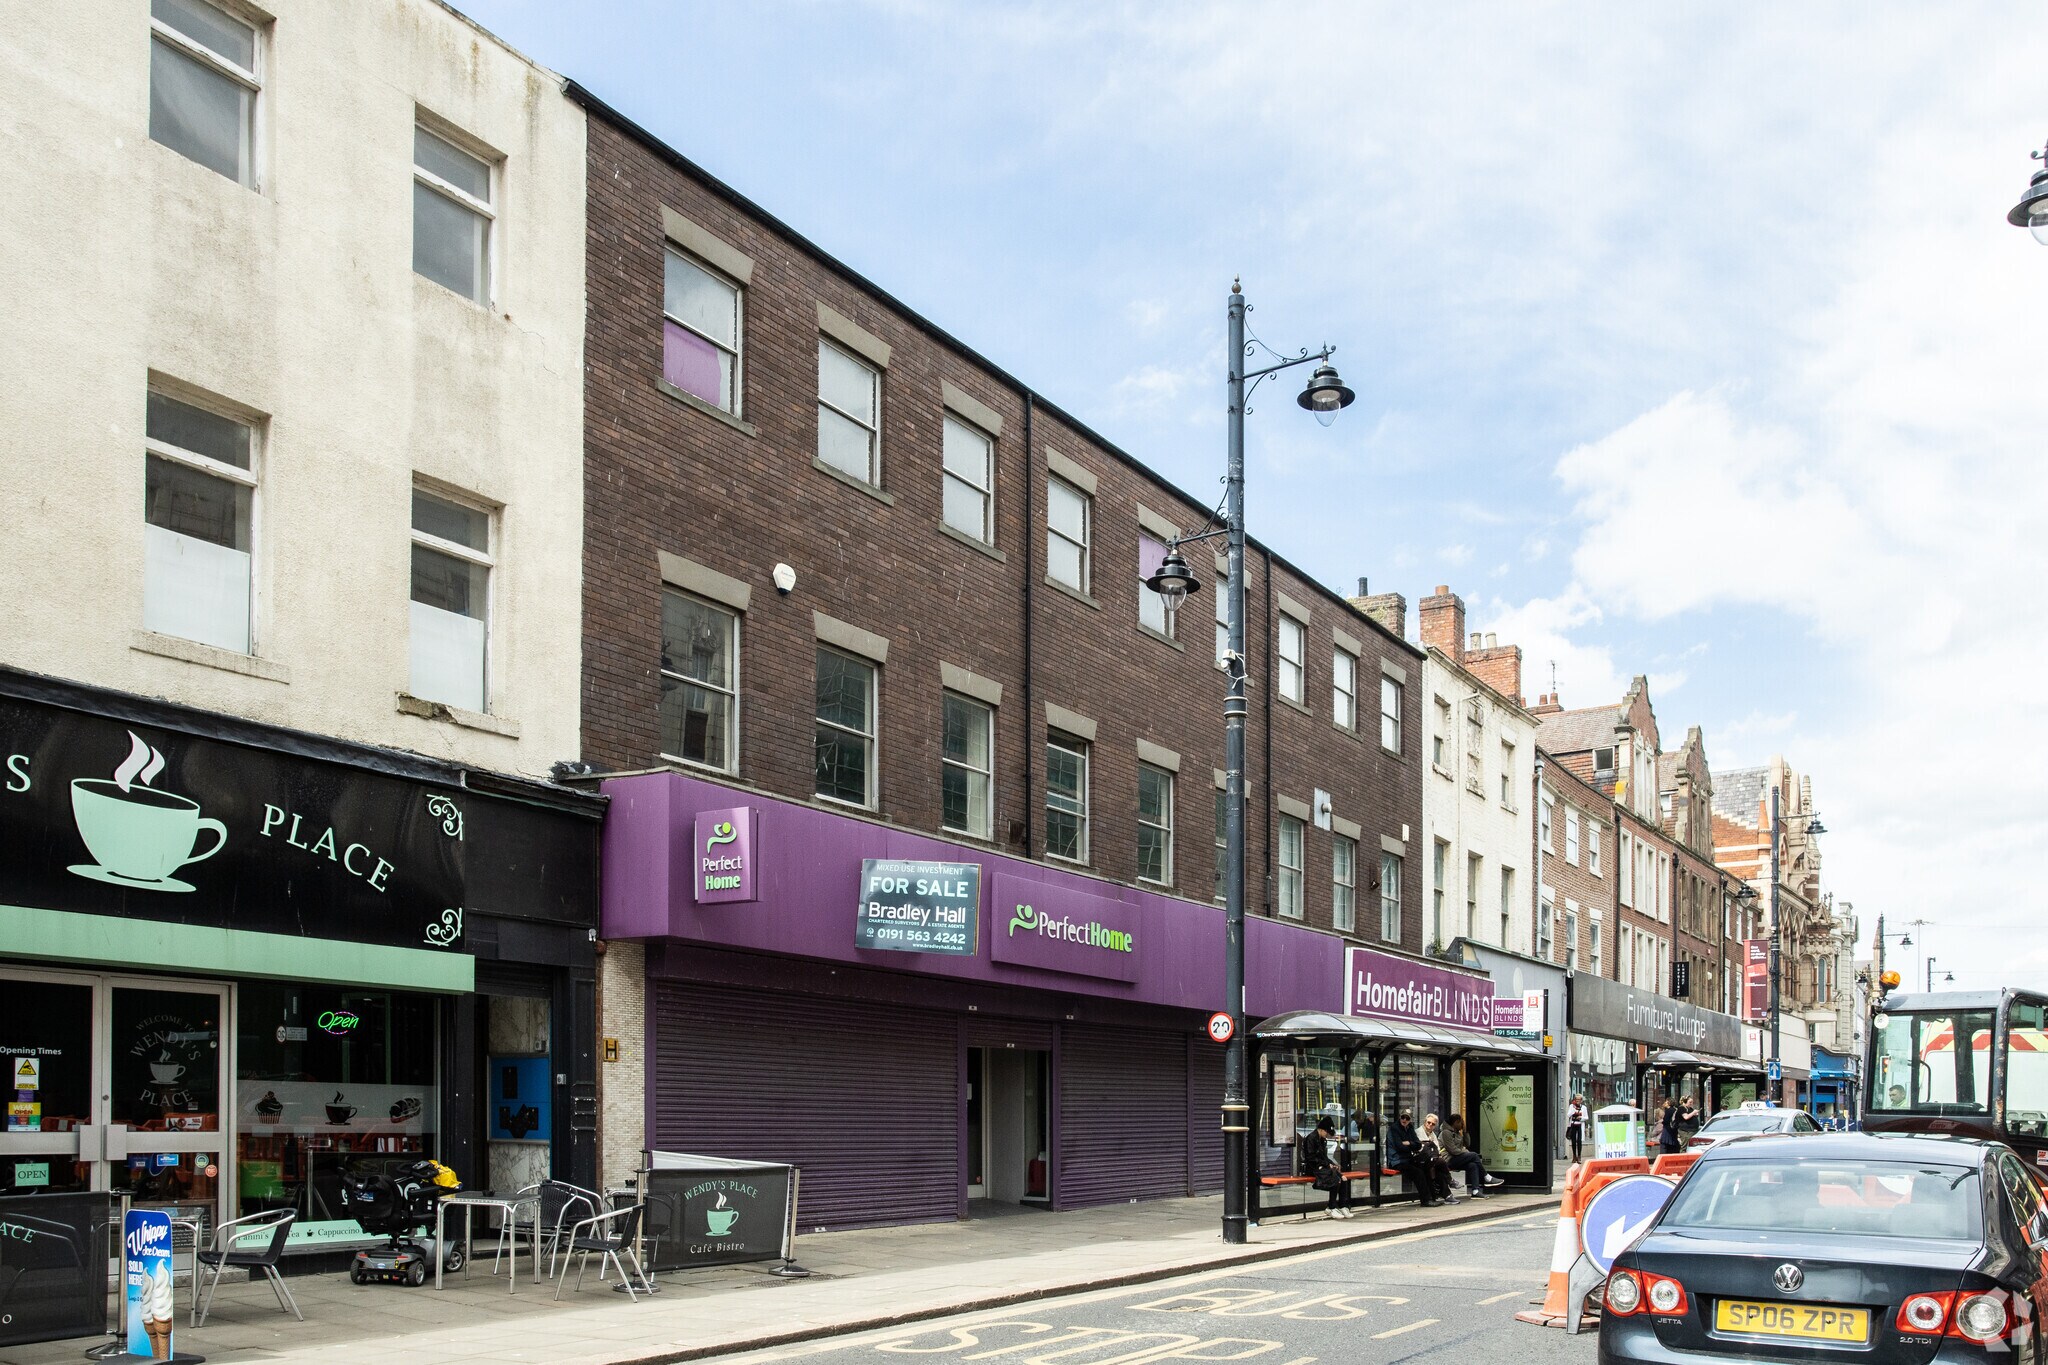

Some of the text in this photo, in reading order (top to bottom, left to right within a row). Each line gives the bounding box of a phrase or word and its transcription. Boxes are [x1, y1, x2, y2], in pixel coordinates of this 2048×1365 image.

[6, 754, 31, 792] S
[260, 803, 395, 893] PLACE
[702, 855, 742, 872] Perfect
[876, 863, 963, 875] MIXED USE INVESTMENT
[705, 875, 741, 890] Home
[869, 876, 968, 898] FOR SALE
[868, 902, 966, 926] Bradley Hall
[877, 928, 966, 944] 0191 563 4242
[1039, 911, 1133, 952] PerfectHome
[1494, 1005, 1523, 1015] Homefair
[1627, 994, 1706, 1045] Furniture Lounge
[136, 1015, 196, 1034] WELCOME TO
[318, 1011, 359, 1030] Open
[1213, 1021, 1230, 1033] 20
[0, 1046, 62, 1055] Opening Times
[130, 1030, 201, 1060] WENDY'S
[605, 1040, 617, 1059] H
[139, 1089, 193, 1107] PLACE
[1615, 1080, 1633, 1102] SALE
[17, 1170, 47, 1180] OPEN
[684, 1180, 758, 1200] WENDY'S PLACE
[127, 1220, 168, 1256] Whippy
[317, 1226, 360, 1238] Cappuccino
[152, 1246, 170, 1257] Cream
[690, 1242, 745, 1254] Café Bistro
[128, 1260, 143, 1273] SOLD
[128, 1273, 143, 1286] HERE
[1124, 1288, 1411, 1321] BUS
[1657, 1317, 1683, 1326] JETTA
[1729, 1304, 1855, 1335] SP06 ZPR
[875, 1319, 1286, 1365] STOP
